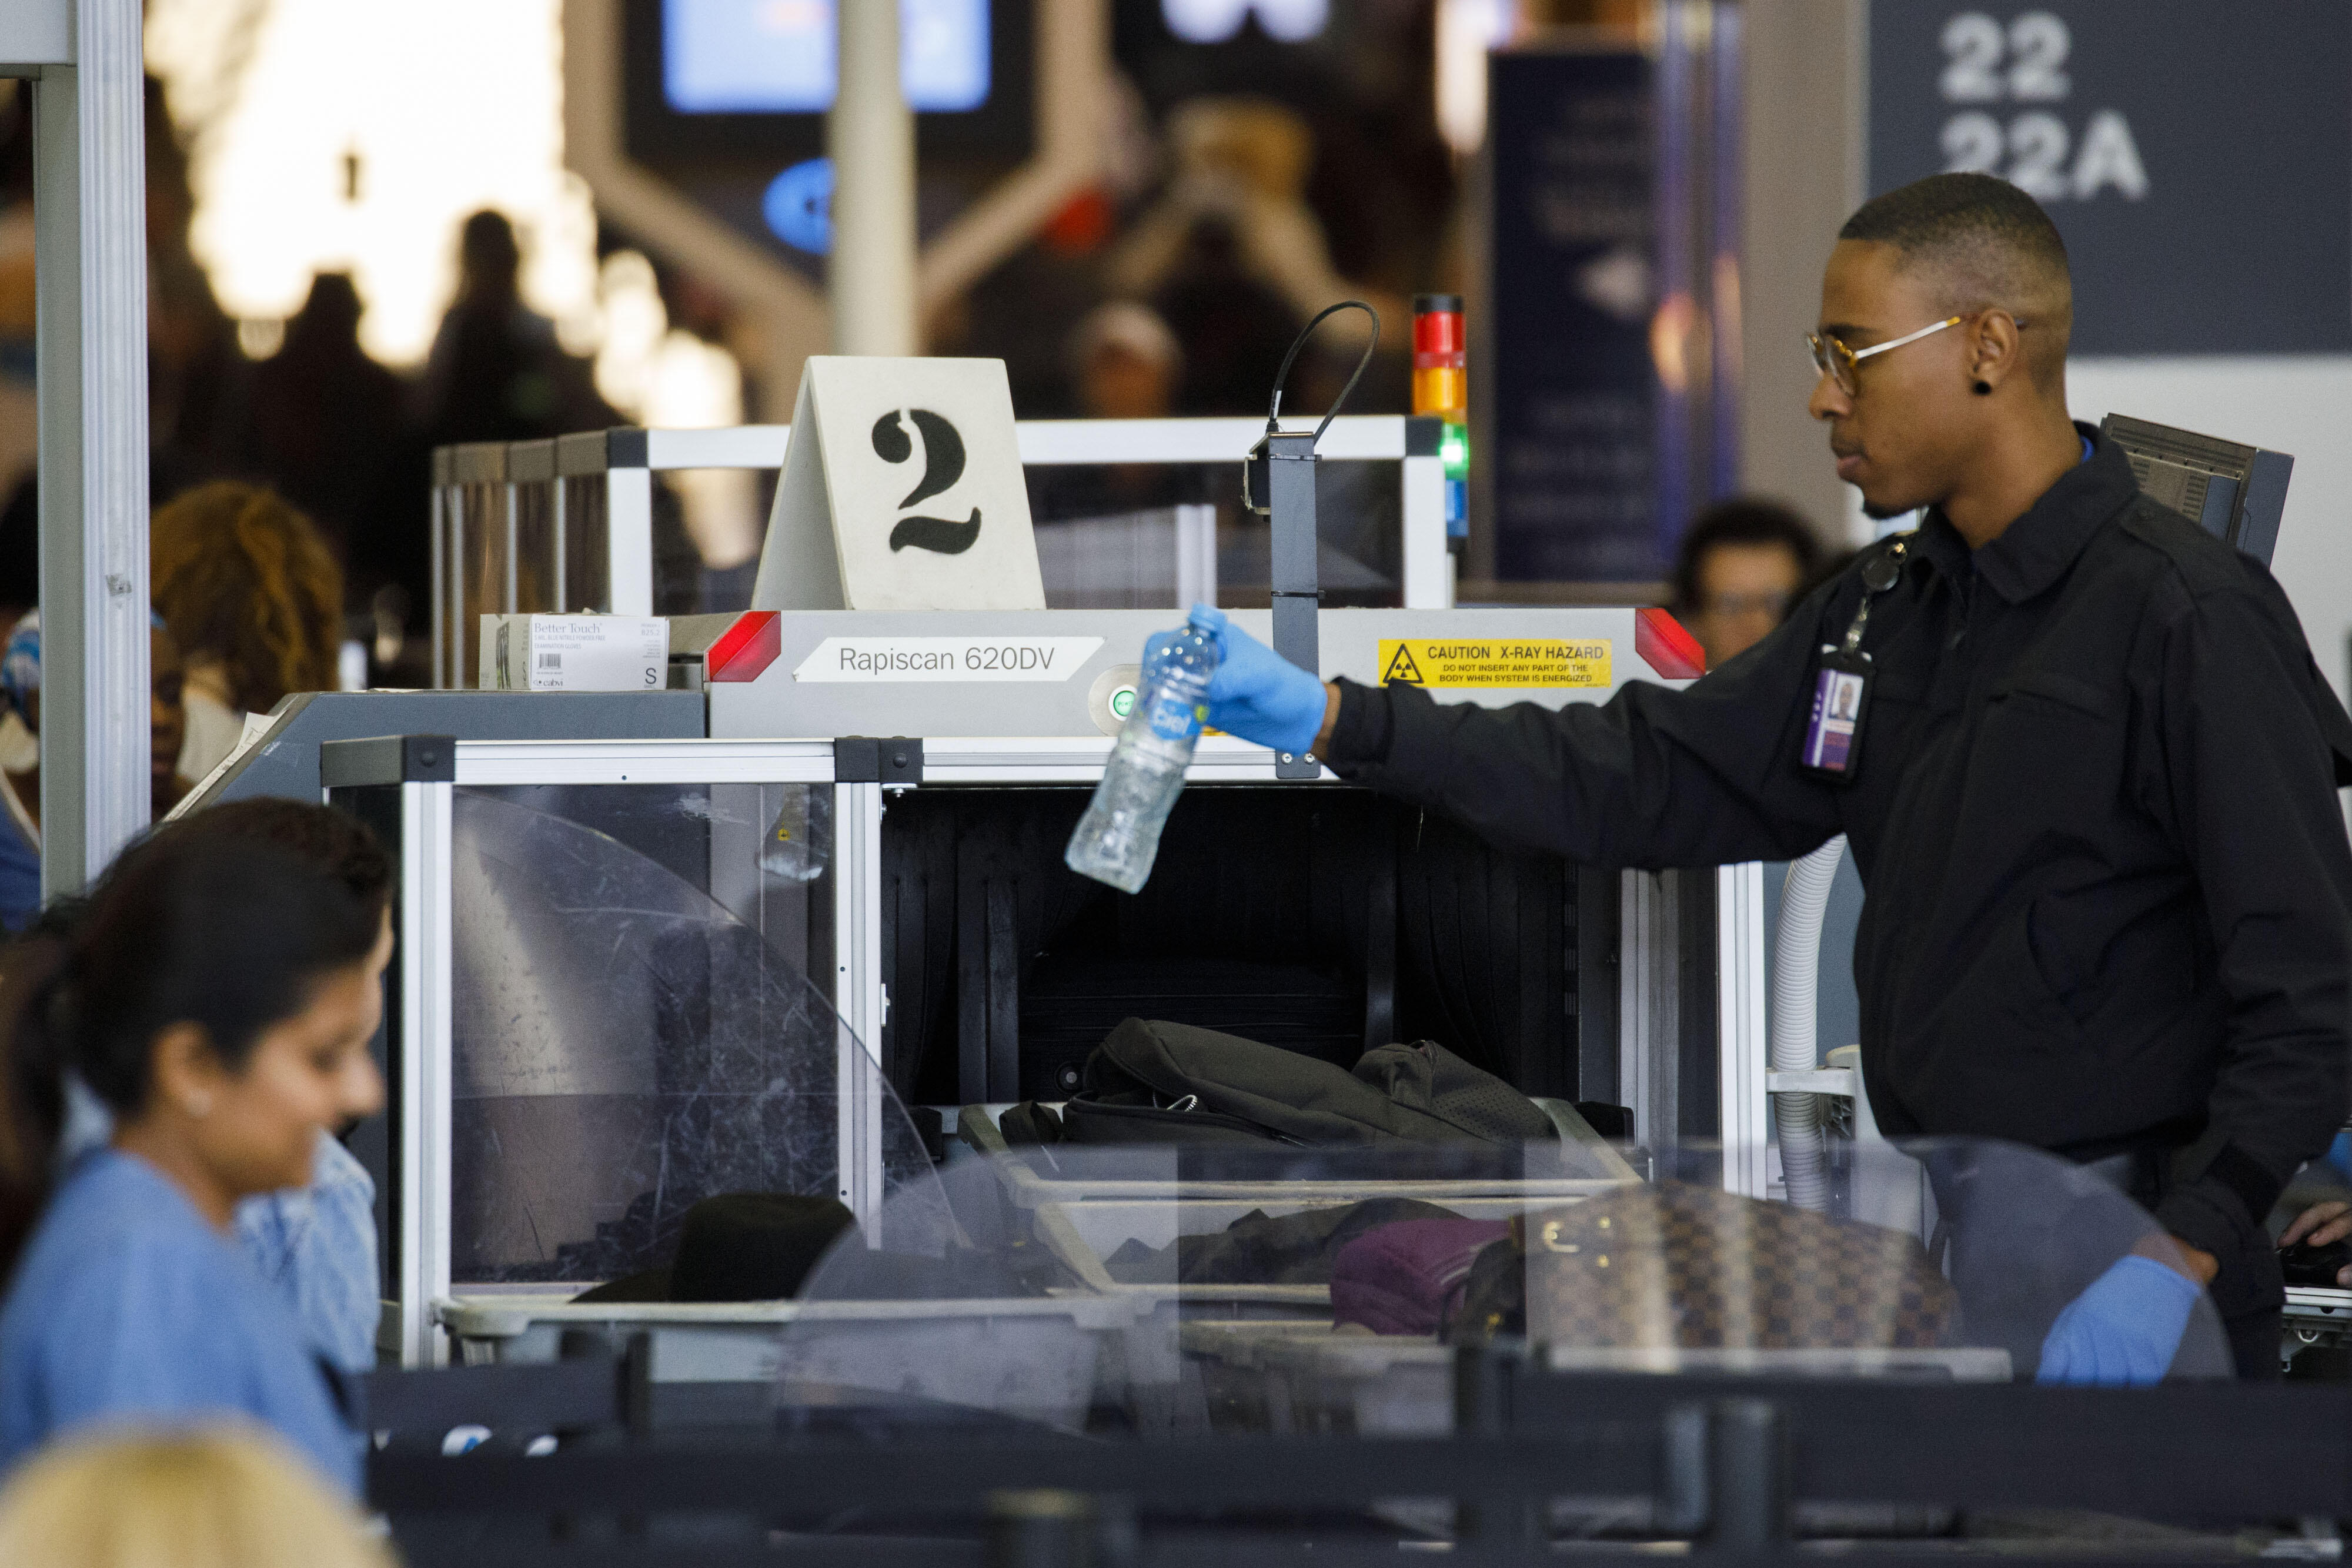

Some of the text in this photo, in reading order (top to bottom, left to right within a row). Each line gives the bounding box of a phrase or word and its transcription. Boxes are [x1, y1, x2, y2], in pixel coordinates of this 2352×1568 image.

[1942, 12, 2070, 101] 22
[1942, 113, 2149, 202] 22A
[871, 409, 981, 555] 2
[534, 623, 600, 633] Better Touch
[840, 647, 1055, 676] Rapiscan 620DV
[1428, 646, 1604, 659] CAUTION X-RAY HAZARD
[645, 667, 657, 684] S
